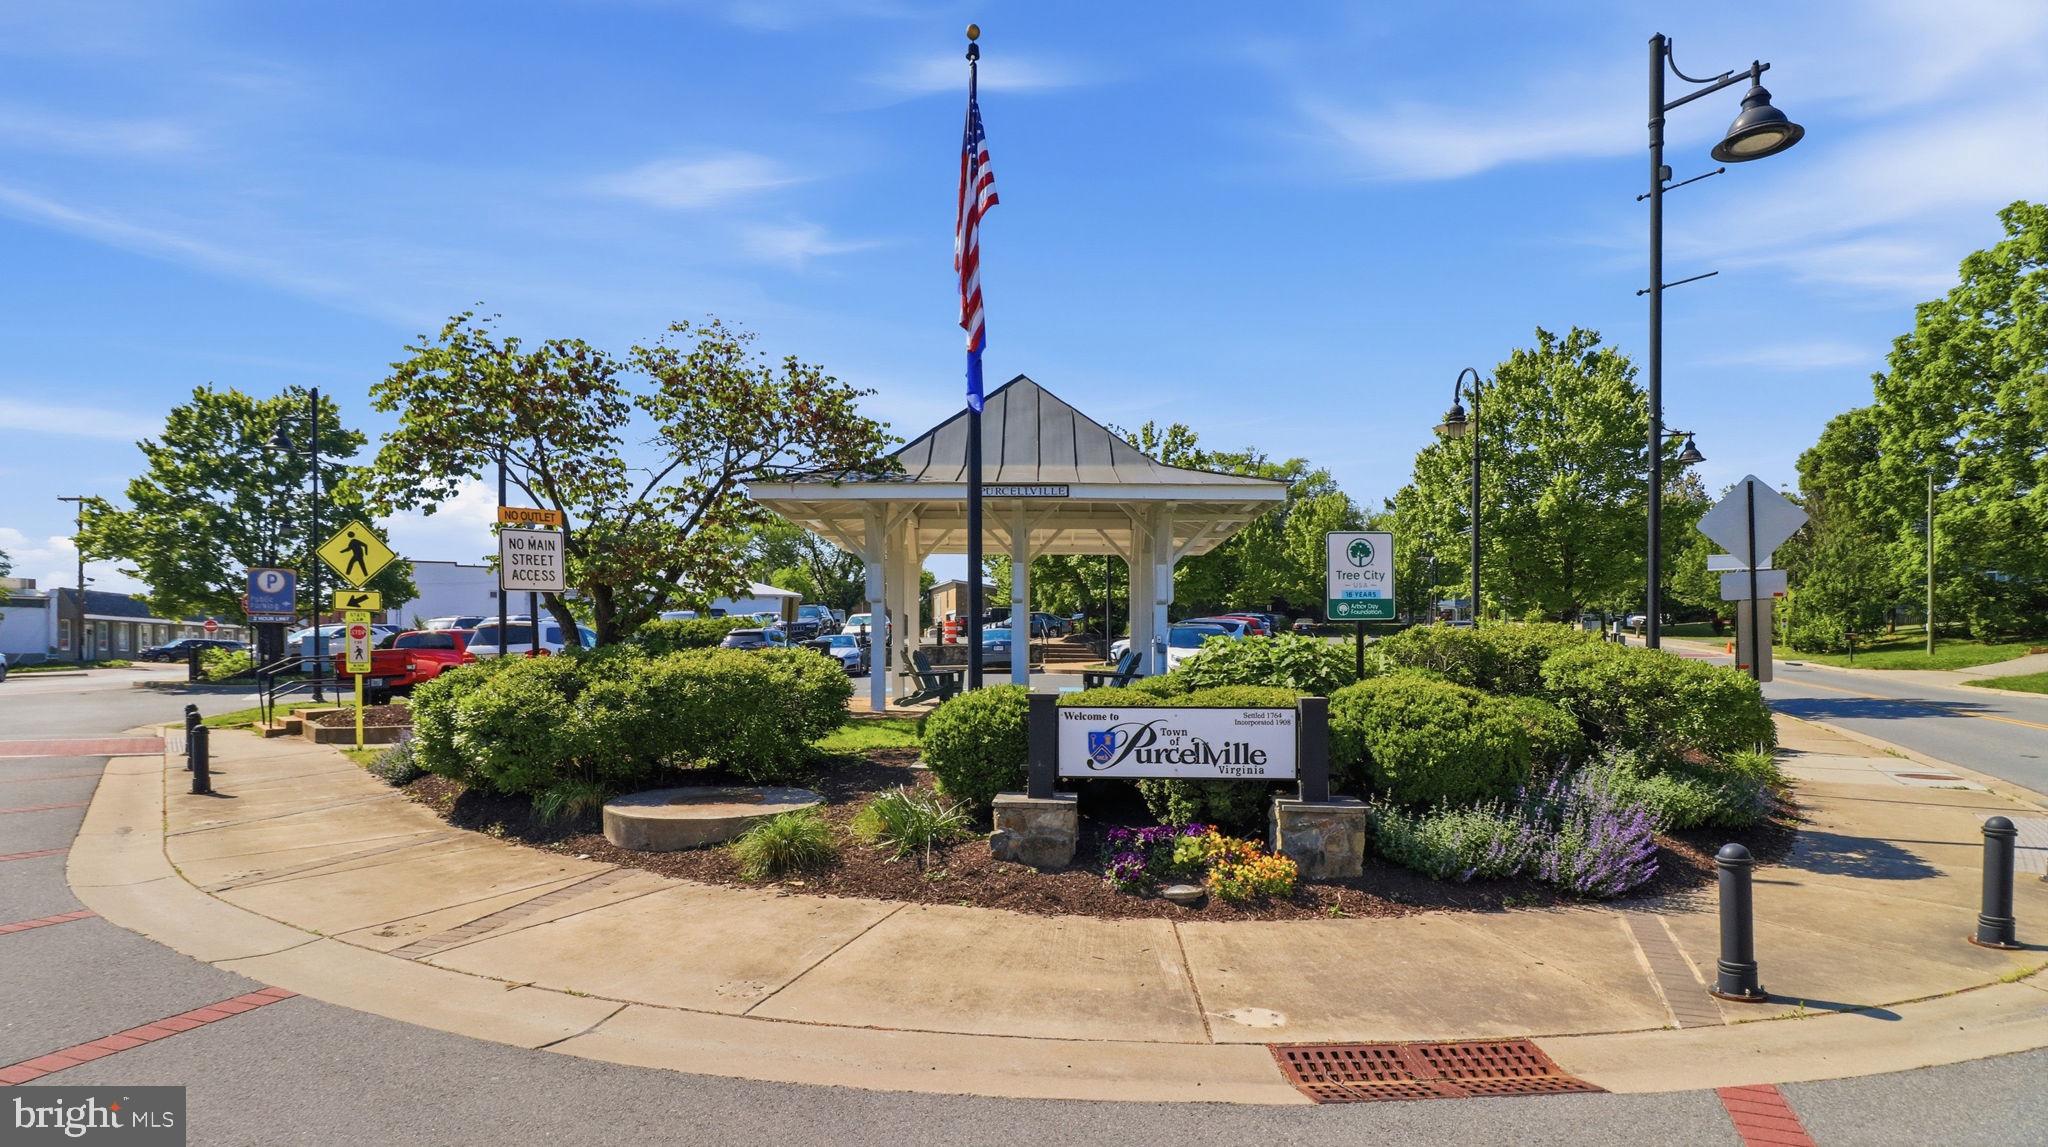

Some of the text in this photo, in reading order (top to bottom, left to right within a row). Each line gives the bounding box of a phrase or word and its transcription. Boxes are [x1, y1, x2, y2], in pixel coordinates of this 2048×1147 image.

[504, 510, 556, 522] NO OUTLET
[508, 538, 555, 551] NO MAIN
[512, 554, 554, 566] STREET
[266, 573, 277, 589] P
[512, 569, 556, 581] ACCESS
[1336, 570, 1385, 582] Tree City
[1064, 711, 1119, 720] Welcome to
[1160, 728, 1188, 737] Town
[1169, 736, 1180, 746] of
[1218, 765, 1265, 777] Virginia
